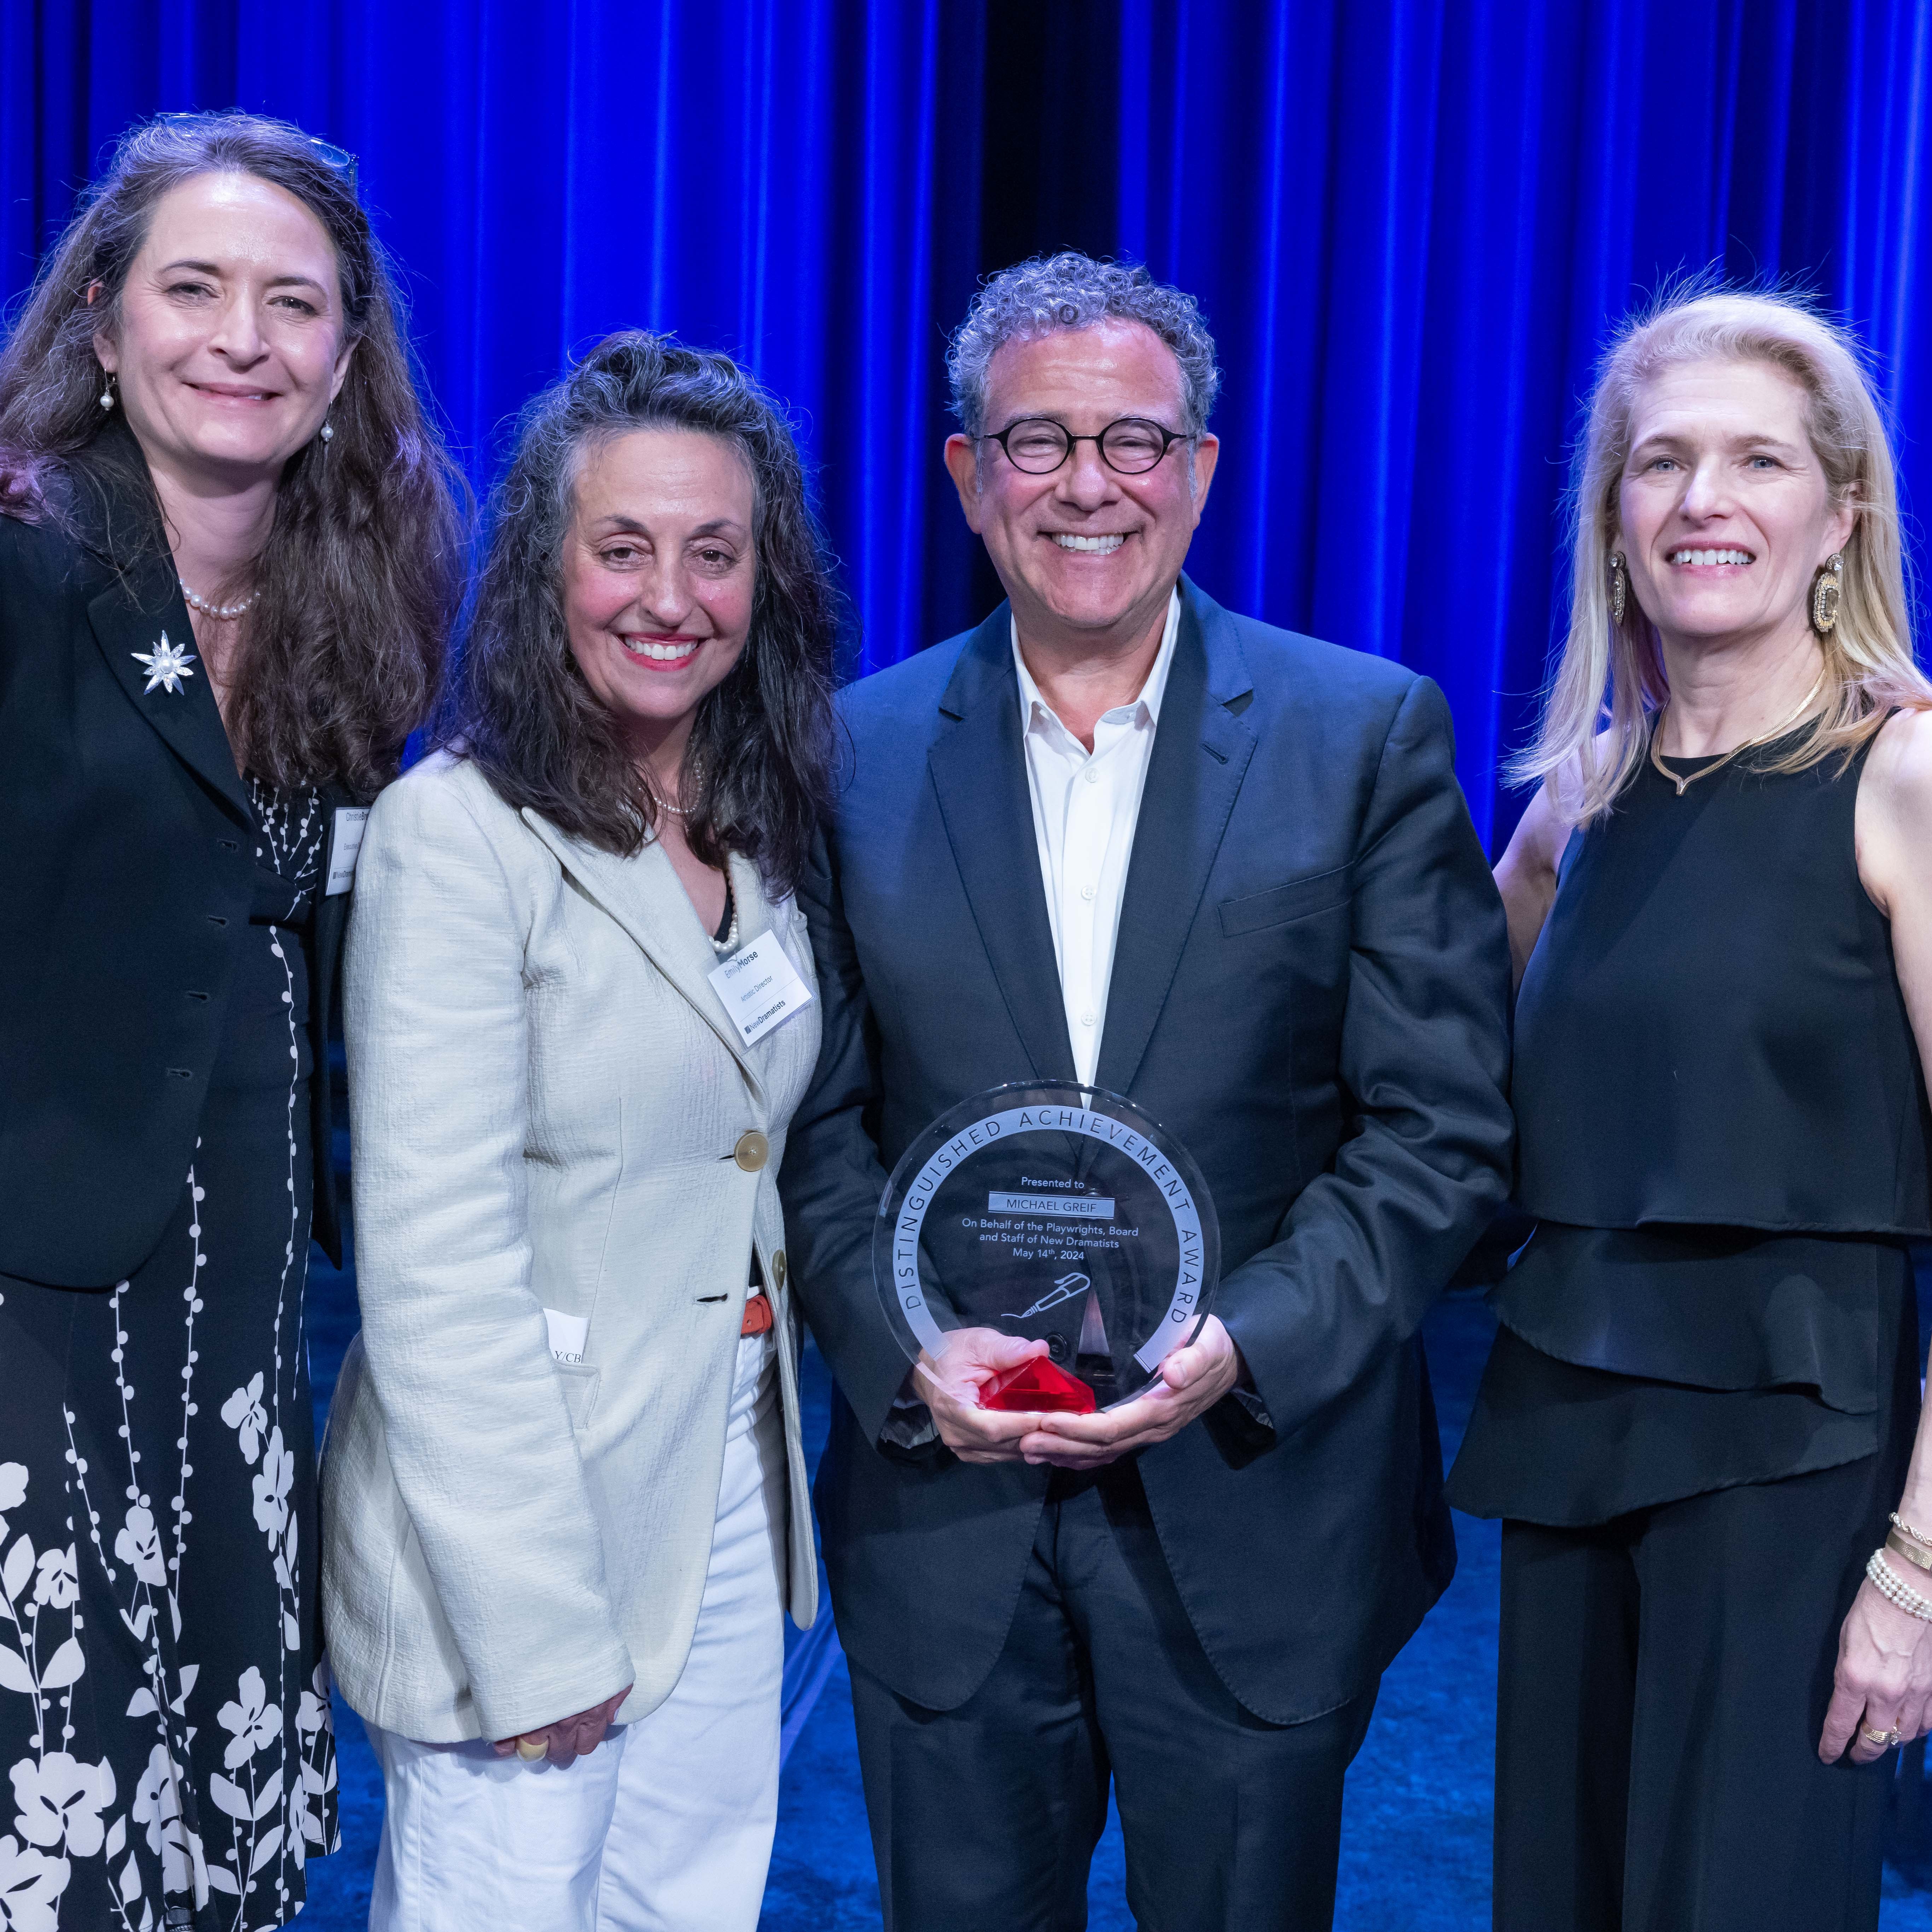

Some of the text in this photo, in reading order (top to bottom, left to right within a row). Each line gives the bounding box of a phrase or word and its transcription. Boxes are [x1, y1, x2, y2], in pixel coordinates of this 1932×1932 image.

[346, 811, 369, 821] ChristieBro
[740, 975, 773, 1002] Artistic Director
[749, 999, 786, 1031] NewDramatists
[1021, 1176, 1071, 1188] Presented
[1007, 1199, 1097, 1212] MICHAEL GREIF
[898, 1110, 1199, 1323] DISTINGUISHED ACHIEVEMENT AWARD
[962, 1218, 1139, 1236] On Behalf of the Playwrights, Board
[979, 1233, 1119, 1248] and Staff of New Dramatists
[1013, 1247, 1084, 1260] May 14th, 2024
[554, 1350, 581, 1363] Y/CB
